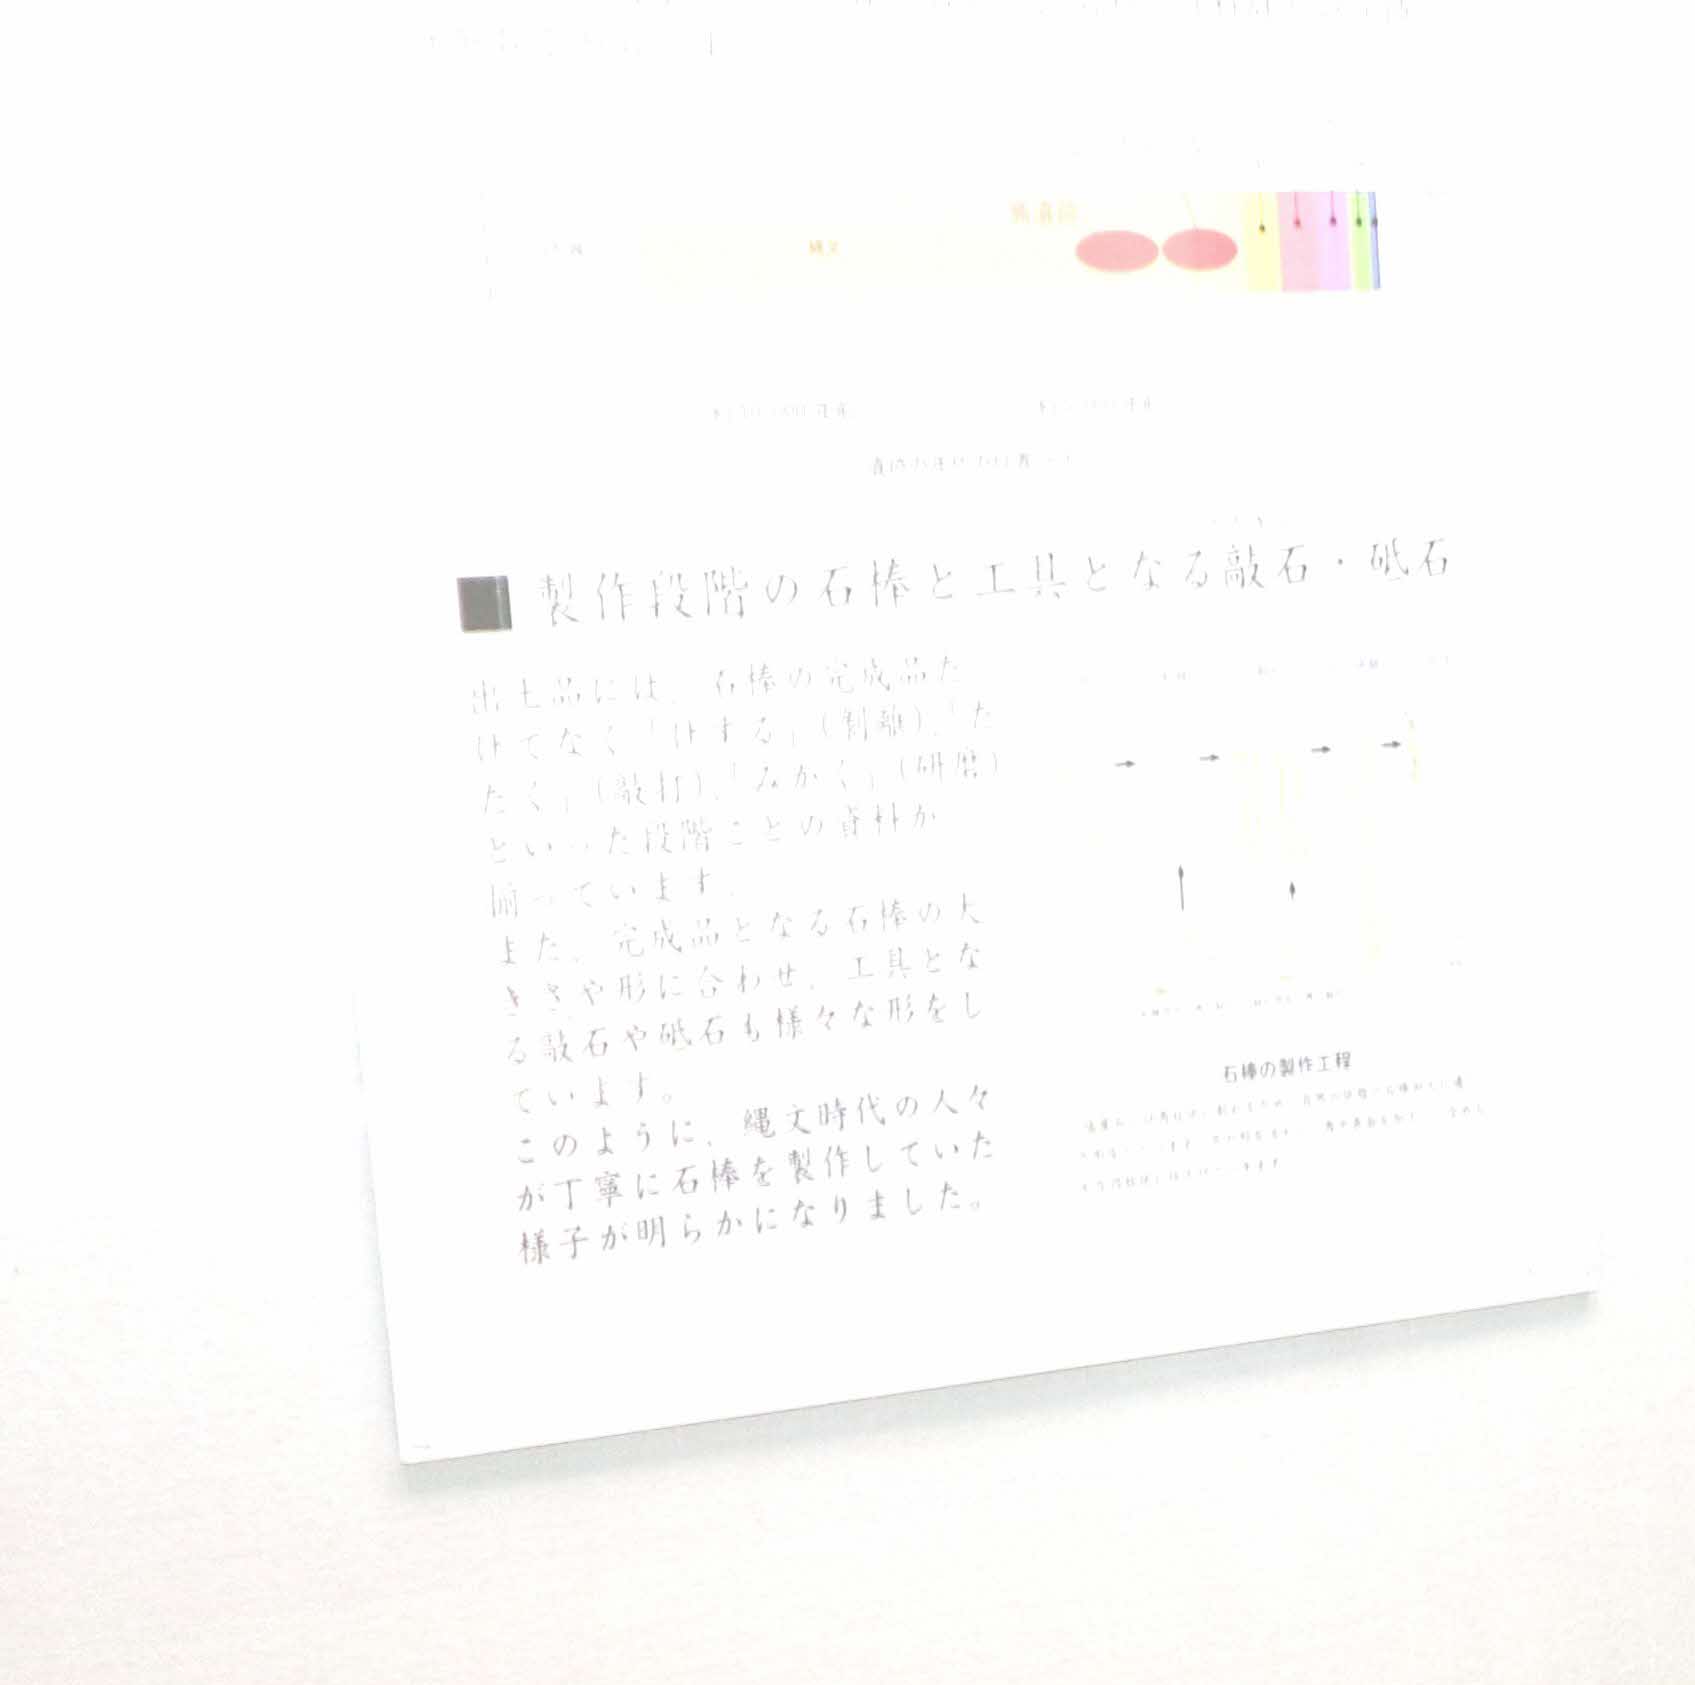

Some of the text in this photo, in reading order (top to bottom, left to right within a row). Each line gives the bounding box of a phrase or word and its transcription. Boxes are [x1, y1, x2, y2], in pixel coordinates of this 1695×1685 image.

[1223, 1050, 1352, 1083] 石棒の製作工程
[514, 1129, 994, 1211] が丁寧に石棒を製作していた
[517, 1180, 981, 1266] 様子が明らかになりました。
